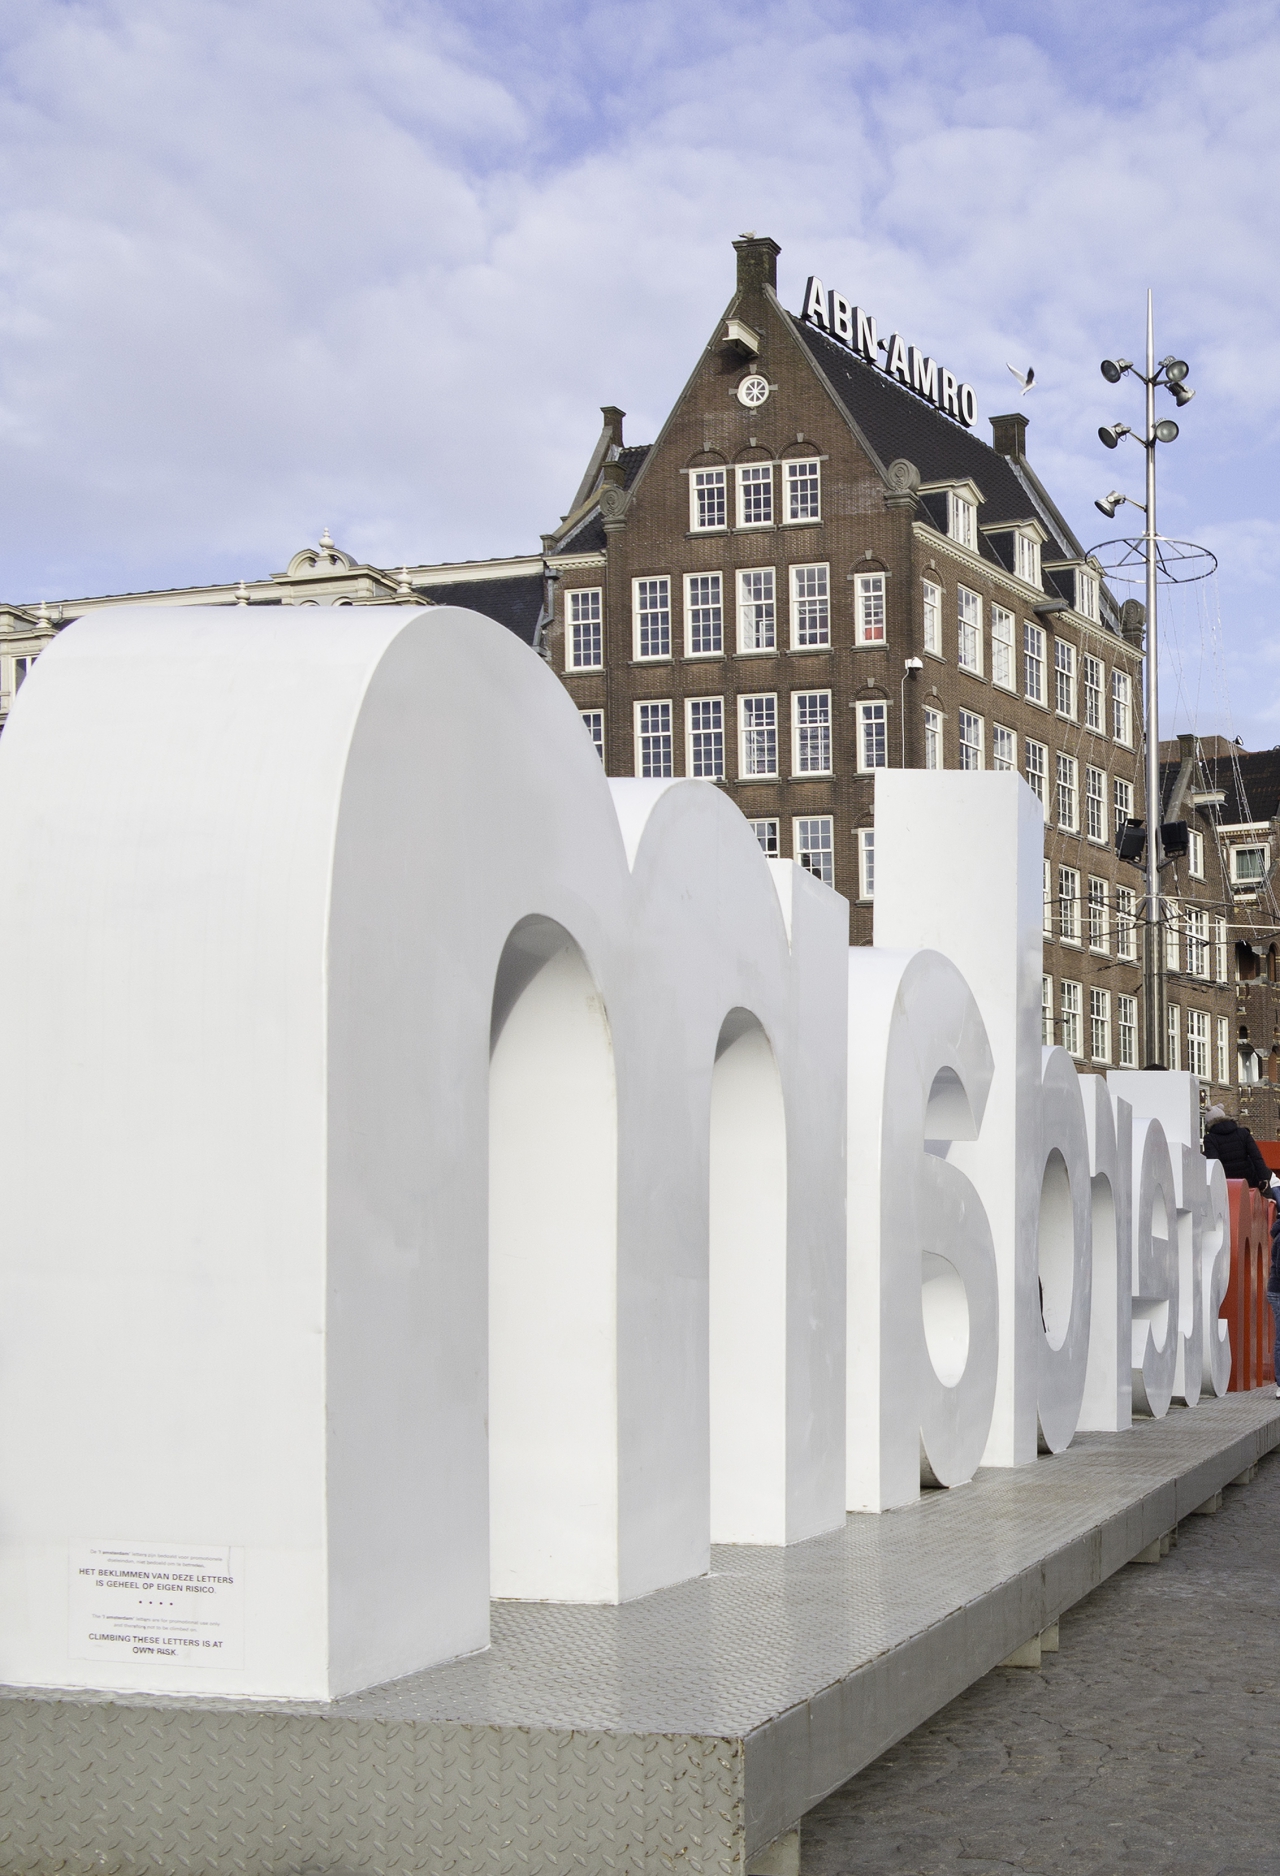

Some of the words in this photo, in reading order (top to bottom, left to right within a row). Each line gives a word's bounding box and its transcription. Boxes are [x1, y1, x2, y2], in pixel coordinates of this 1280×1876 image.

[79, 1568, 95, 1576] HET
[98, 1569, 150, 1579] BEKLIMMEN
[151, 1572, 169, 1580] VAN
[172, 1573, 194, 1582] DEZE
[196, 1575, 234, 1584] LETTERS
[95, 1579, 104, 1587] IS
[106, 1580, 139, 1589] GEHEEL
[142, 1582, 155, 1590] OP
[157, 1583, 183, 1592] EIGEN
[185, 1585, 217, 1594] RISICO.
[88, 1633, 131, 1643] CLIMBING
[132, 1636, 160, 1644] THESE
[162, 1637, 200, 1647] LETTERS
[132, 1646, 155, 1655] OWN
[156, 1648, 179, 1656] RISK.
